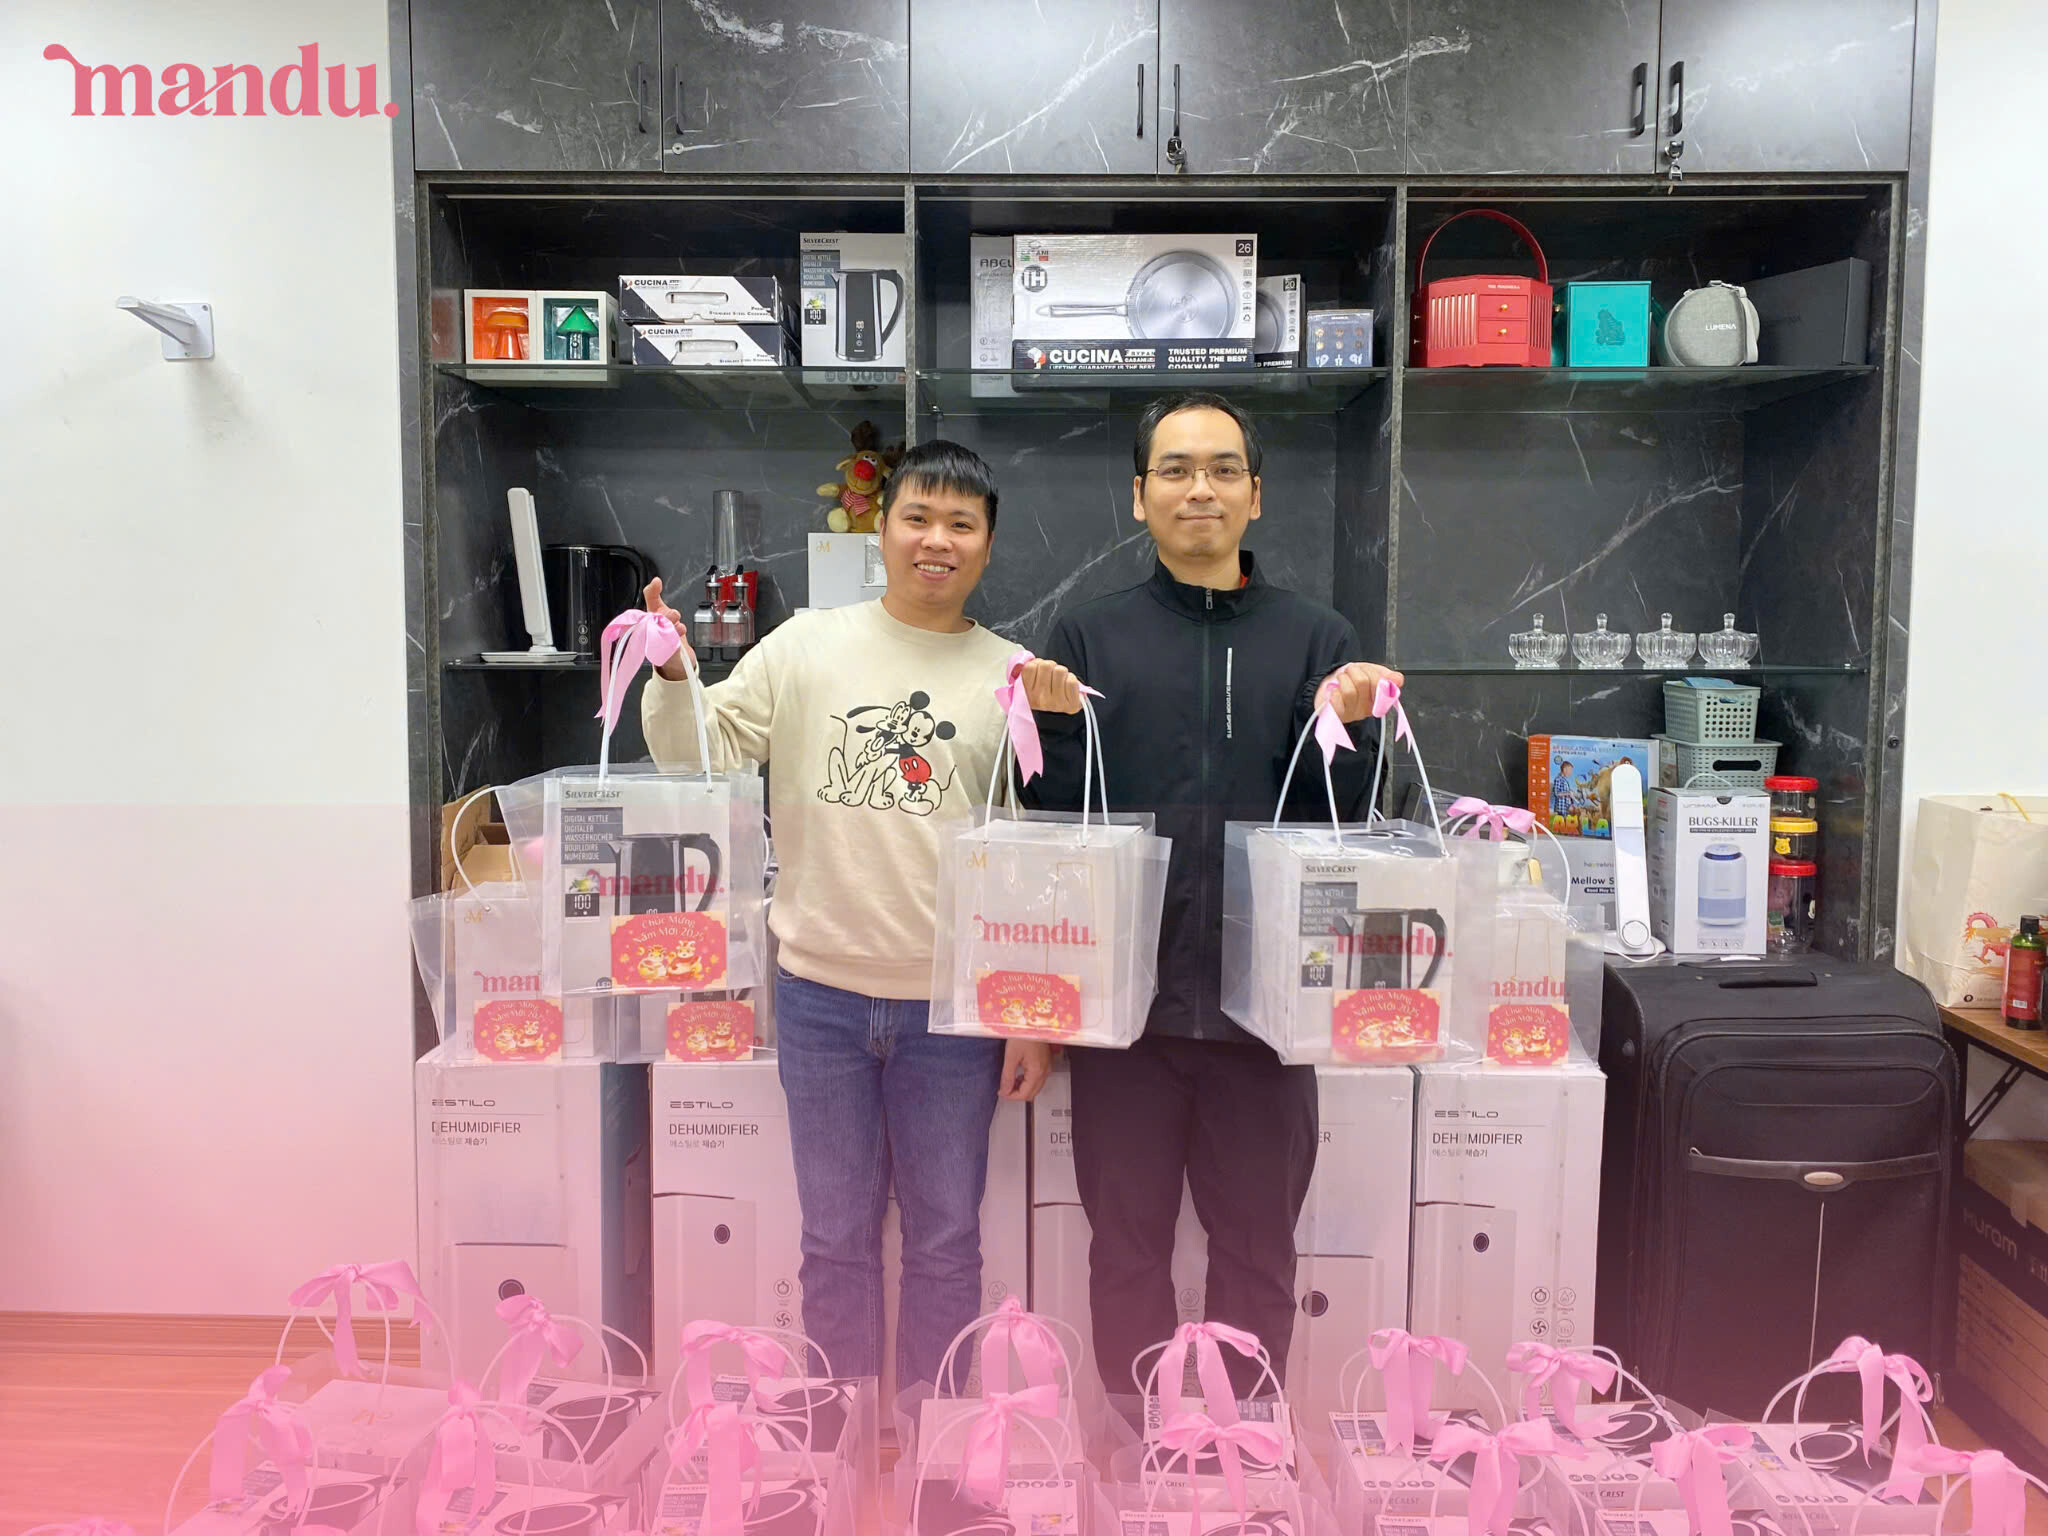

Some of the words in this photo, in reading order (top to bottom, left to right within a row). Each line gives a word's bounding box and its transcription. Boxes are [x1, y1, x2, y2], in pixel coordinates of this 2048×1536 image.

[1238, 243, 1251, 253] 26
[1285, 280, 1295, 288] 20
[1050, 349, 1123, 363] CUCINA
[565, 815, 586, 823] DIGITAL
[588, 815, 608, 823] KETTLE
[1689, 816, 1759, 827] BUGS-KILLER
[565, 825, 594, 833] DIGITALER
[565, 833, 613, 841] WASSERKOCHER
[1305, 865, 1357, 873] SILVERCREST
[586, 865, 725, 897] mandu.
[1571, 876, 1606, 885] Mellow
[574, 895, 591, 909] 100
[973, 914, 1097, 946] mandu.
[1328, 925, 1453, 957] mandu.
[1309, 966, 1326, 980] 100
[474, 971, 541, 992] man
[432, 1099, 496, 1107] ESTILO
[670, 1101, 734, 1109] ESTILO
[669, 1123, 759, 1135] DEHUMIDIFIER
[702, 1139, 725, 1149] 제습기
